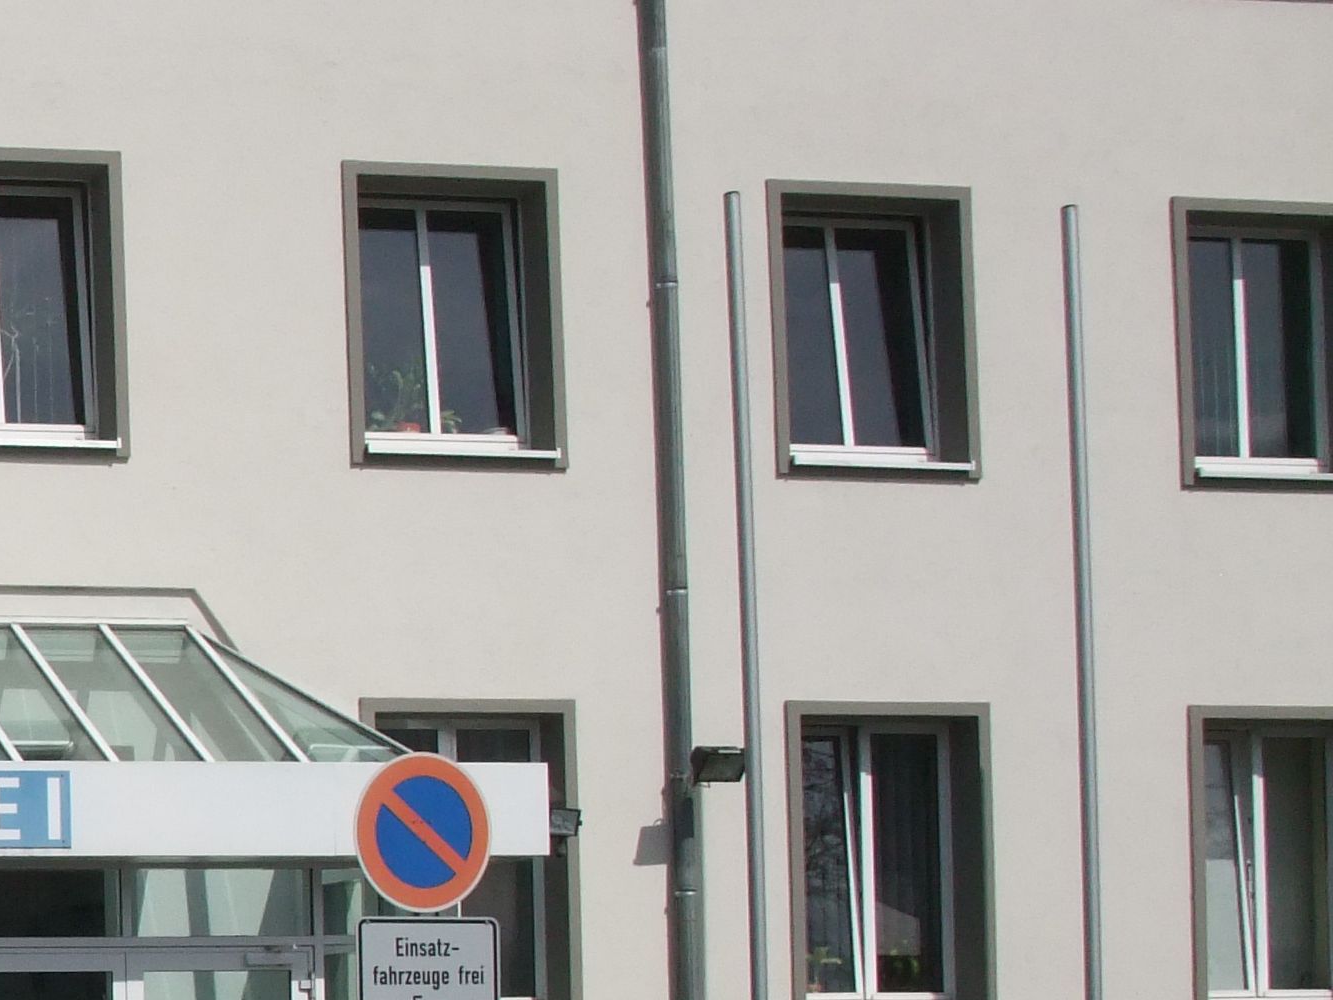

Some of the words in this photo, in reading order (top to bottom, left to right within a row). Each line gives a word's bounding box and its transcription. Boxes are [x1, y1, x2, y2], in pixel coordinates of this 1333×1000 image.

[395, 937, 460, 957] Einsatz-
[373, 966, 450, 990] fahrzeuge
[458, 965, 485, 985] frei
